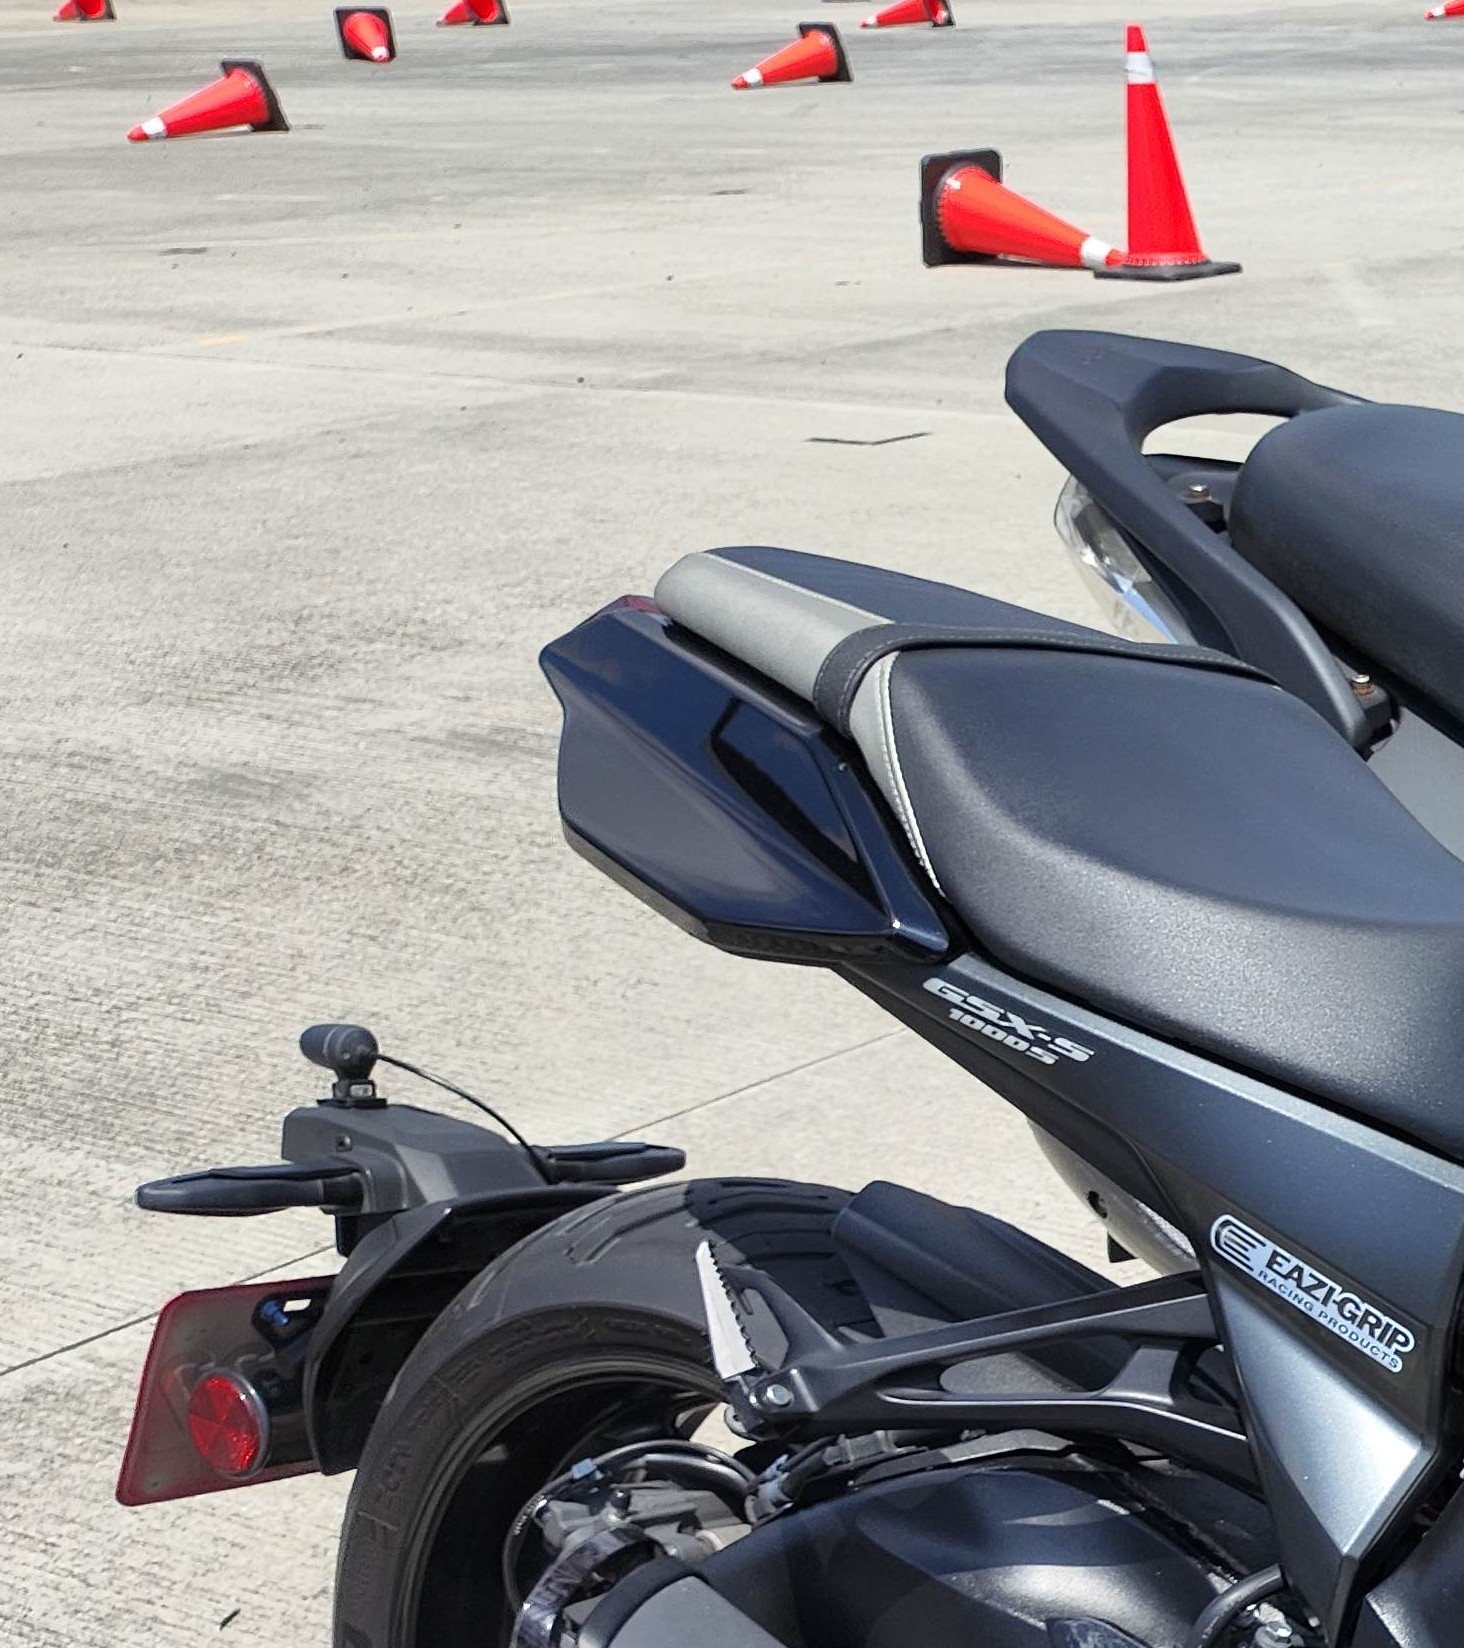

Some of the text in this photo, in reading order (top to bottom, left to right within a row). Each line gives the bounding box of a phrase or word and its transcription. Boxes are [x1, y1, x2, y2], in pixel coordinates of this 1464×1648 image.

[923, 977, 1095, 1062] GSX-S
[949, 1008, 1059, 1065] 1000S
[1258, 1270, 1400, 1370] RACING PRODUCTS
[1265, 1249, 1411, 1355] EAZI-GRIP
